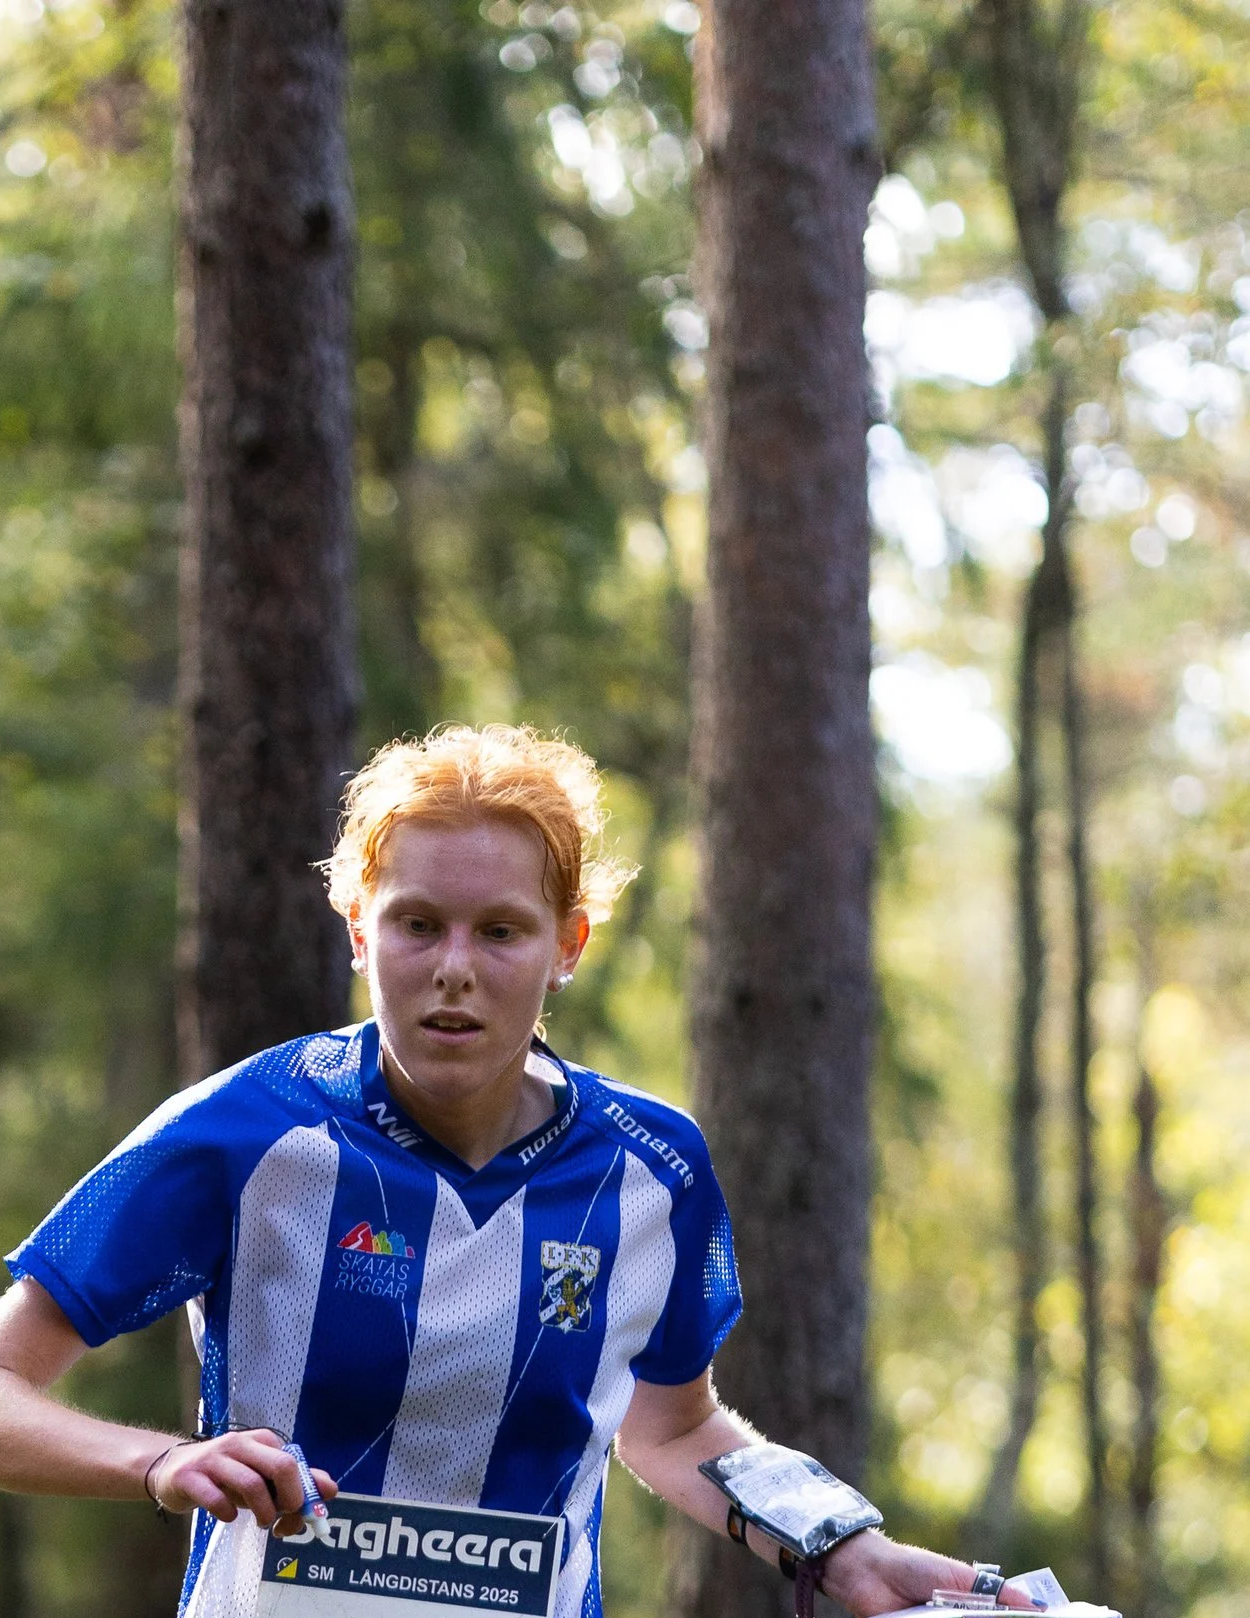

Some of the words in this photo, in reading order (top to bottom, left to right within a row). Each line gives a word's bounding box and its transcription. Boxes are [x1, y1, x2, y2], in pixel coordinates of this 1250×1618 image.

[335, 1271, 408, 1300] RYGGAR
[307, 1564, 335, 1582] SM
[349, 1568, 475, 1600] LÅNGDISTANS
[479, 1586, 519, 1605] 2025
